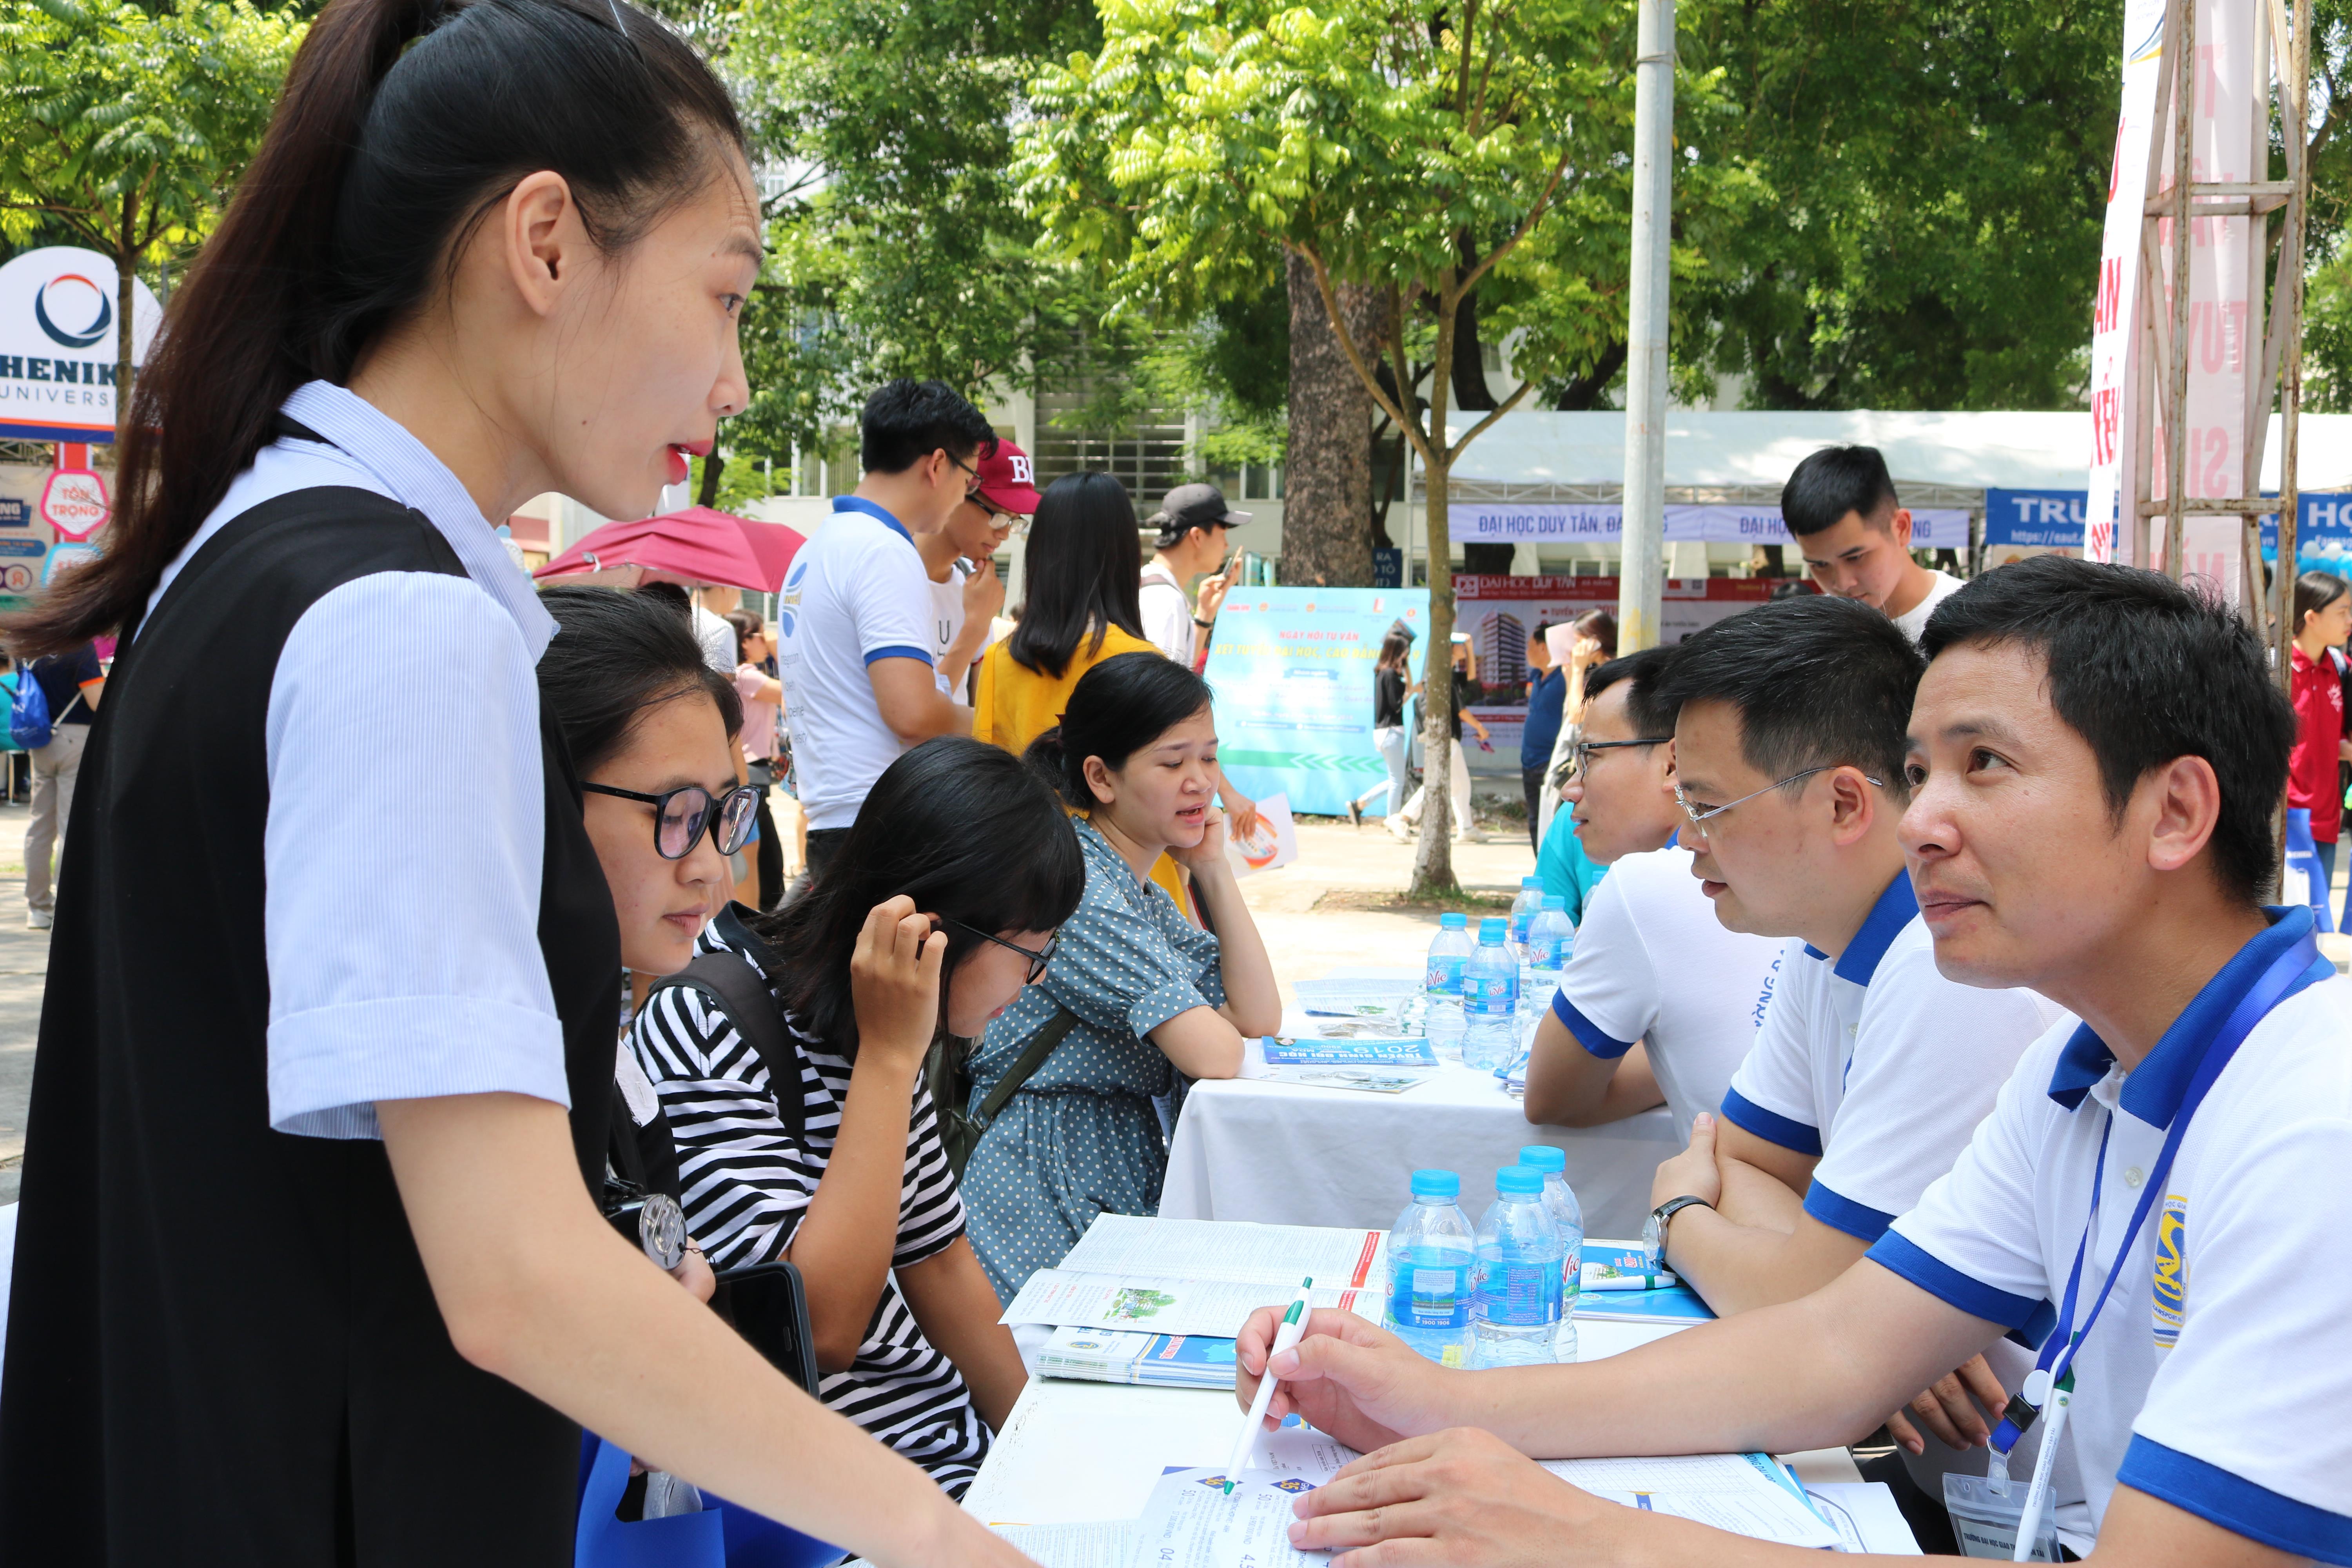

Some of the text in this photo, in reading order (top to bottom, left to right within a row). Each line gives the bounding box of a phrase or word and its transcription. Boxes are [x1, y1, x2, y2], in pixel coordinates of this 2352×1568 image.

[0, 355, 118, 386] HENIK
[0, 385, 109, 406] UNIVERS
[53, 505, 99, 519] TRỌNG
[1479, 515, 1502, 536] ĐẠI
[1507, 515, 1534, 535] HỌC
[1539, 516, 1566, 533] DUY
[1740, 517, 1763, 539] ĐẠI
[1326, 647, 1349, 658] CAO
[1353, 1044, 1419, 1054] 2019
[1205, 1477, 1225, 1486] 36
[1280, 1480, 1300, 1490] 35
[1964, 1532, 1980, 1543] TRƯỜNG
[1980, 1536, 1989, 1546] ĐẠI
[1989, 1539, 1998, 1548] HỌC
[1999, 1541, 2010, 1550] GIAO
[1158, 1548, 1175, 1561] 04
